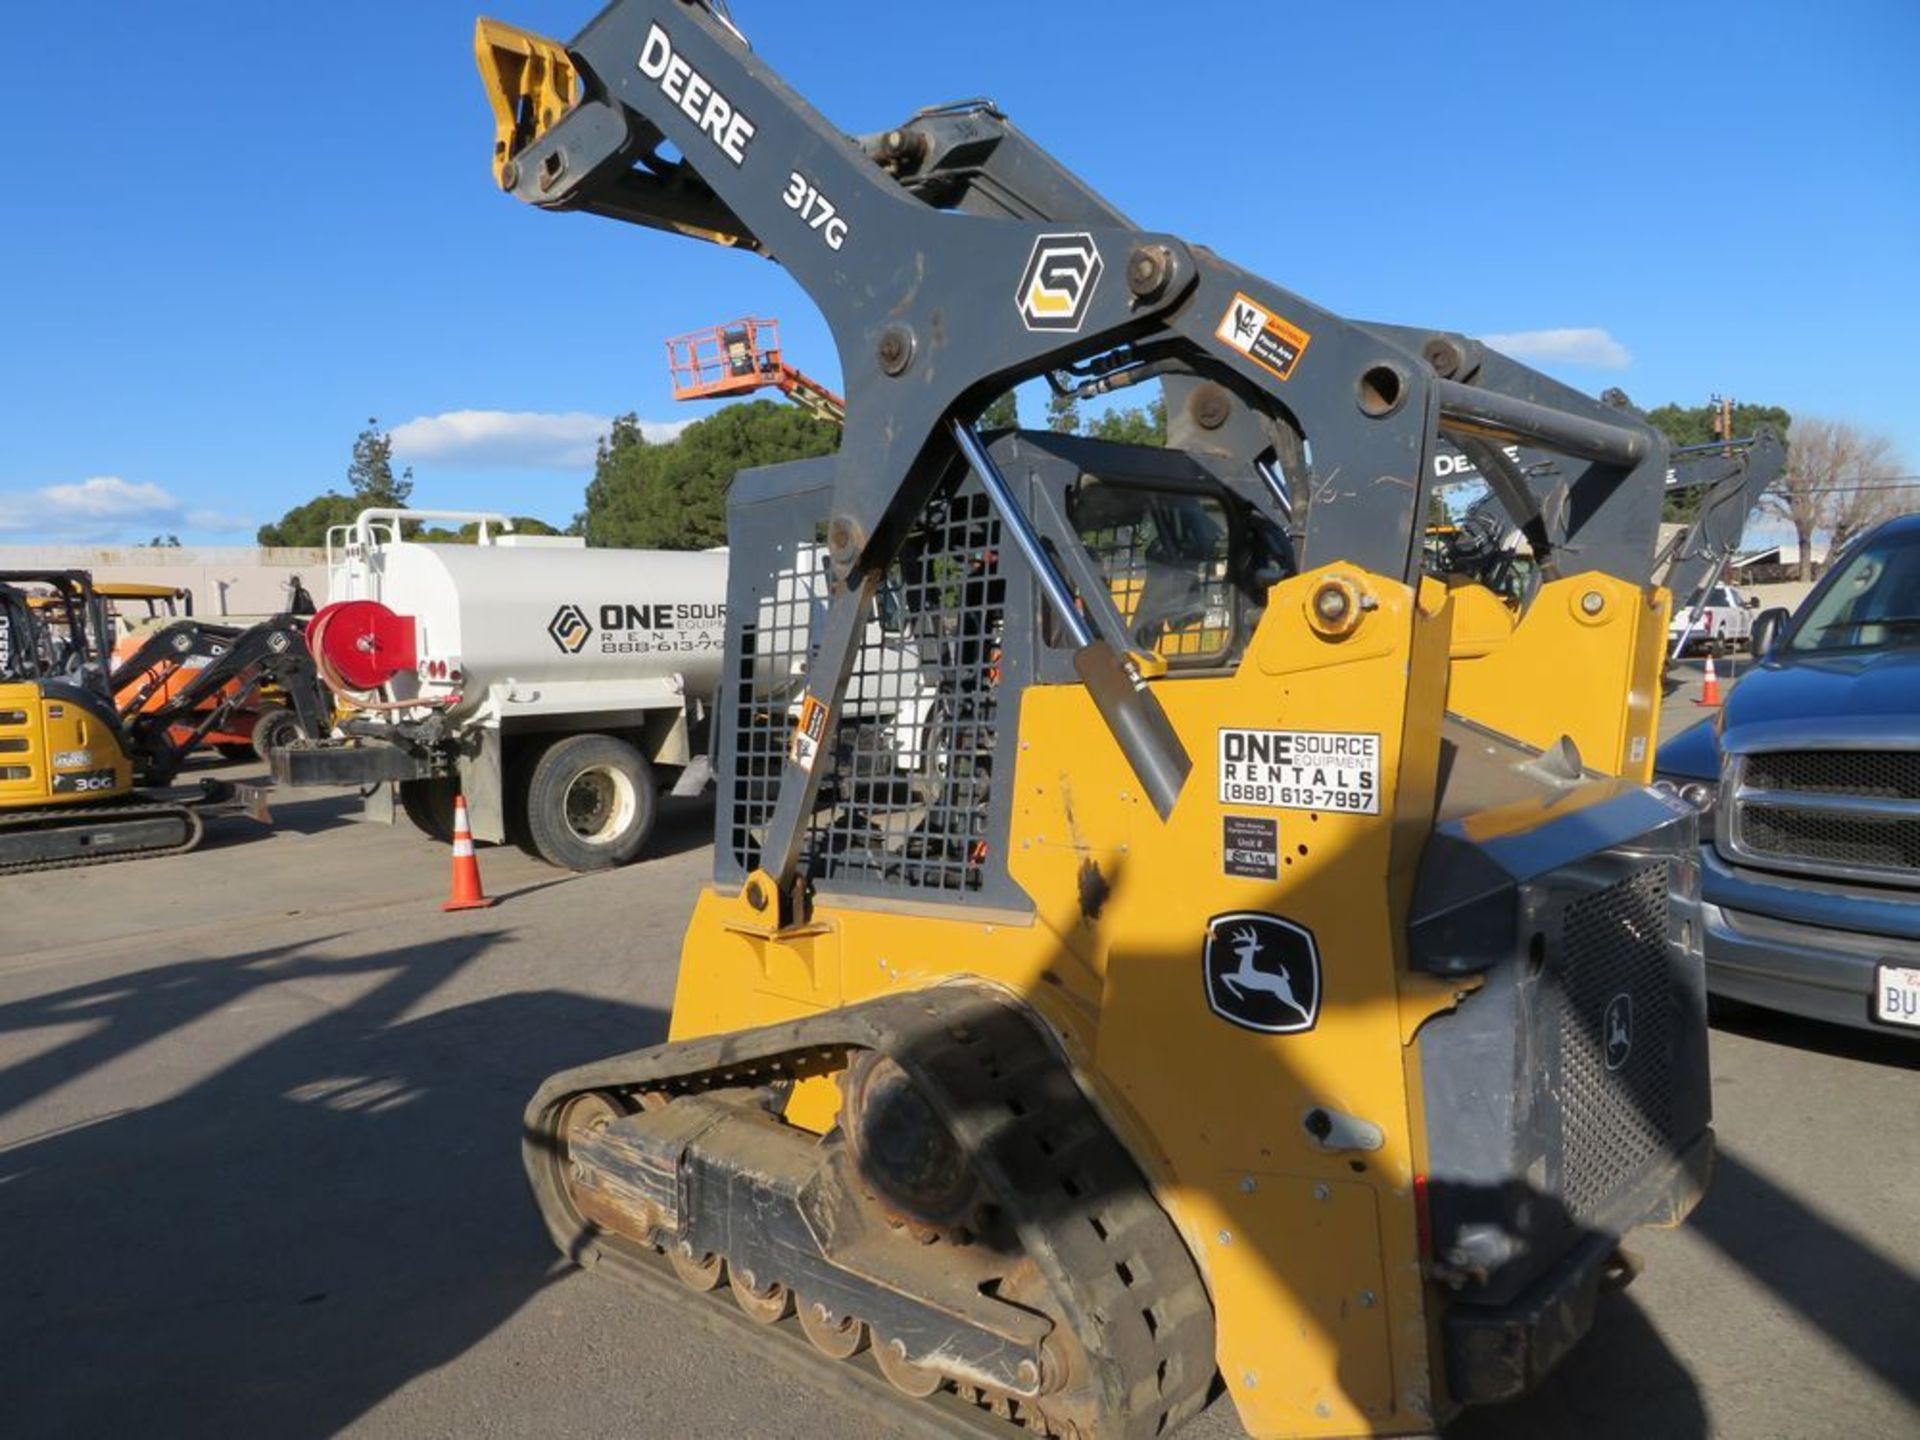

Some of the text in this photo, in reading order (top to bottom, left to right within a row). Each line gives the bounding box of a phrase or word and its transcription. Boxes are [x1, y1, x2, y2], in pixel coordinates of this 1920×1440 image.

[638, 23, 756, 166] DEERE
[782, 171, 848, 251] 317G
[600, 604, 674, 630] ONE
[1225, 733, 1374, 765] ONE SOURCE
[1293, 753, 1373, 769] EQUIPMENT
[1225, 763, 1373, 790] RENTALS
[1224, 781, 1374, 810] (888) 613-7997
